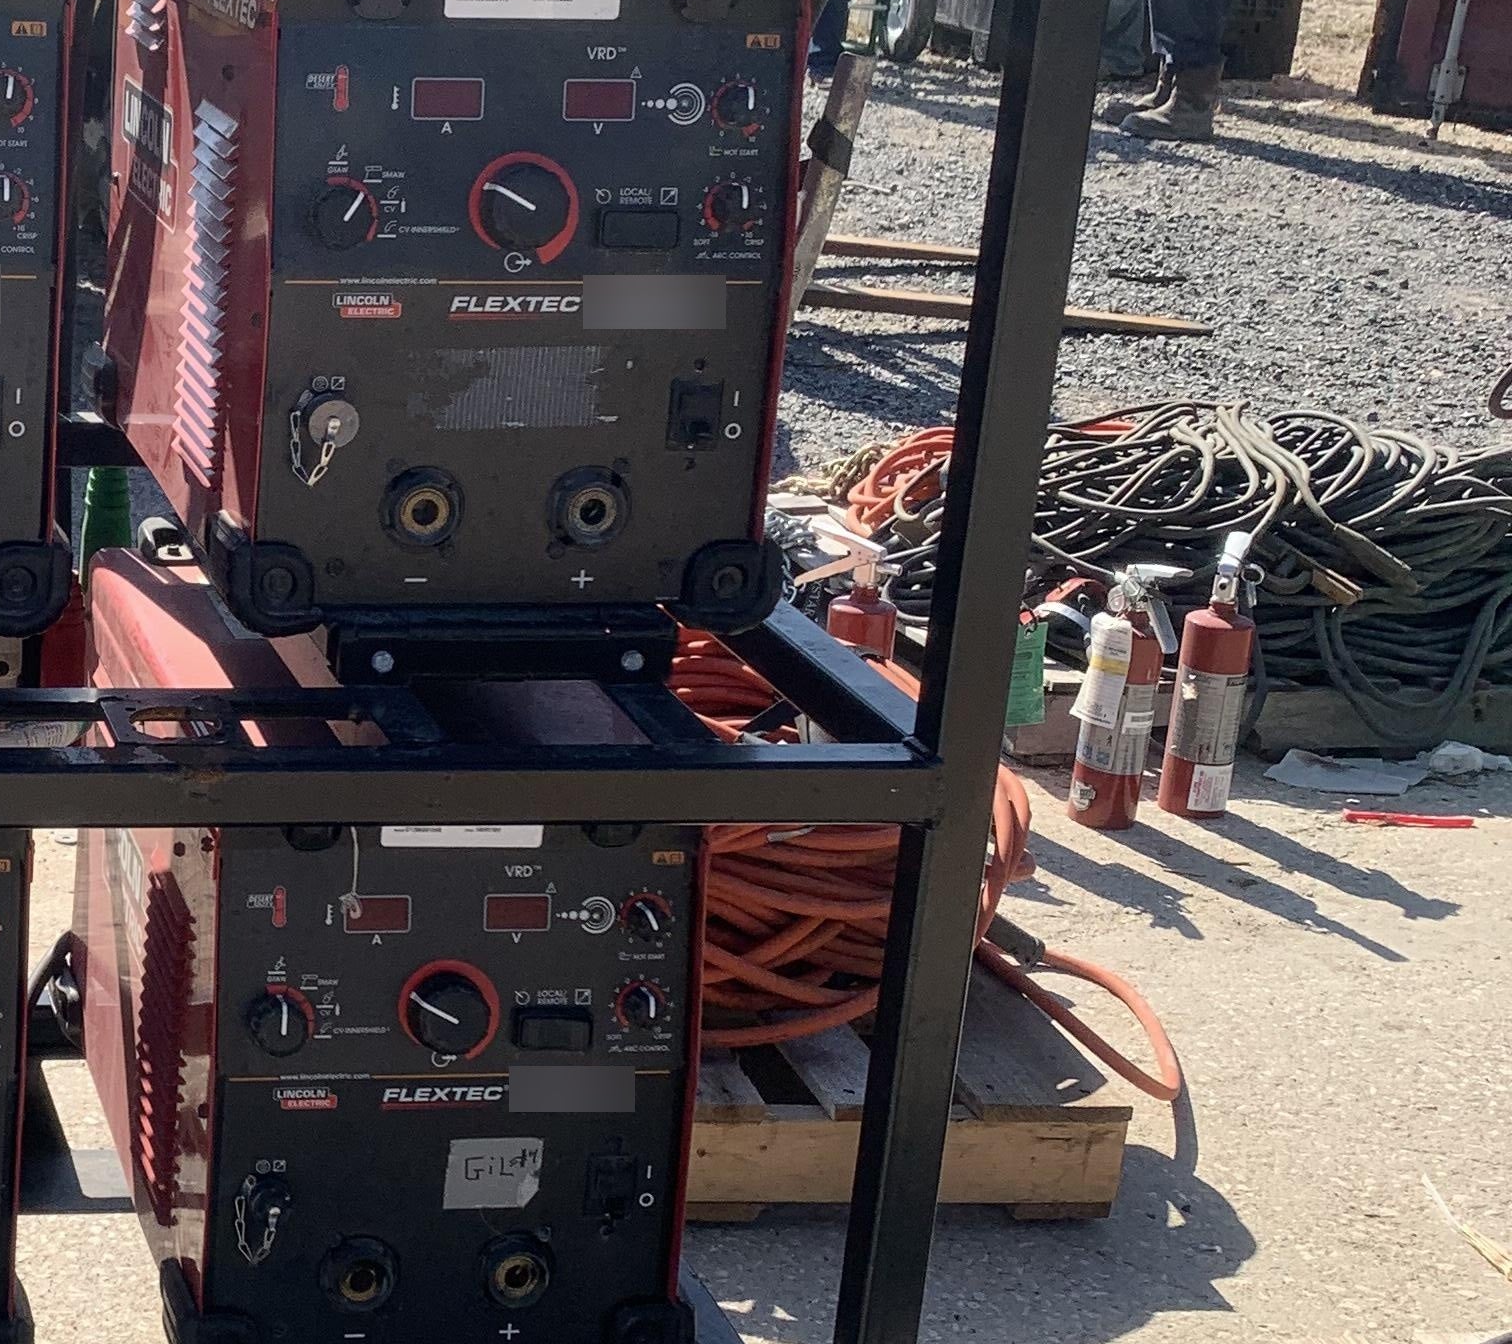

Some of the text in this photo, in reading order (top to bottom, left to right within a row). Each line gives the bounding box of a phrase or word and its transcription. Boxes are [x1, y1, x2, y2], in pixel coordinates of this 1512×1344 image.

[440, 121, 453, 134] A
[593, 122, 603, 135] V
[1, 246, 36, 254] CONTROL
[340, 277, 437, 285] www.lincolnelectric.com
[337, 295, 389, 306] LINCOLN
[450, 296, 581, 312] FLEXTEC
[372, 934, 382, 945] A
[512, 932, 522, 944] V
[279, 1072, 371, 1081] www.lincolnelectric.com
[276, 1089, 327, 1099] LINCOLN
[382, 1086, 504, 1102] FLEXTEC
